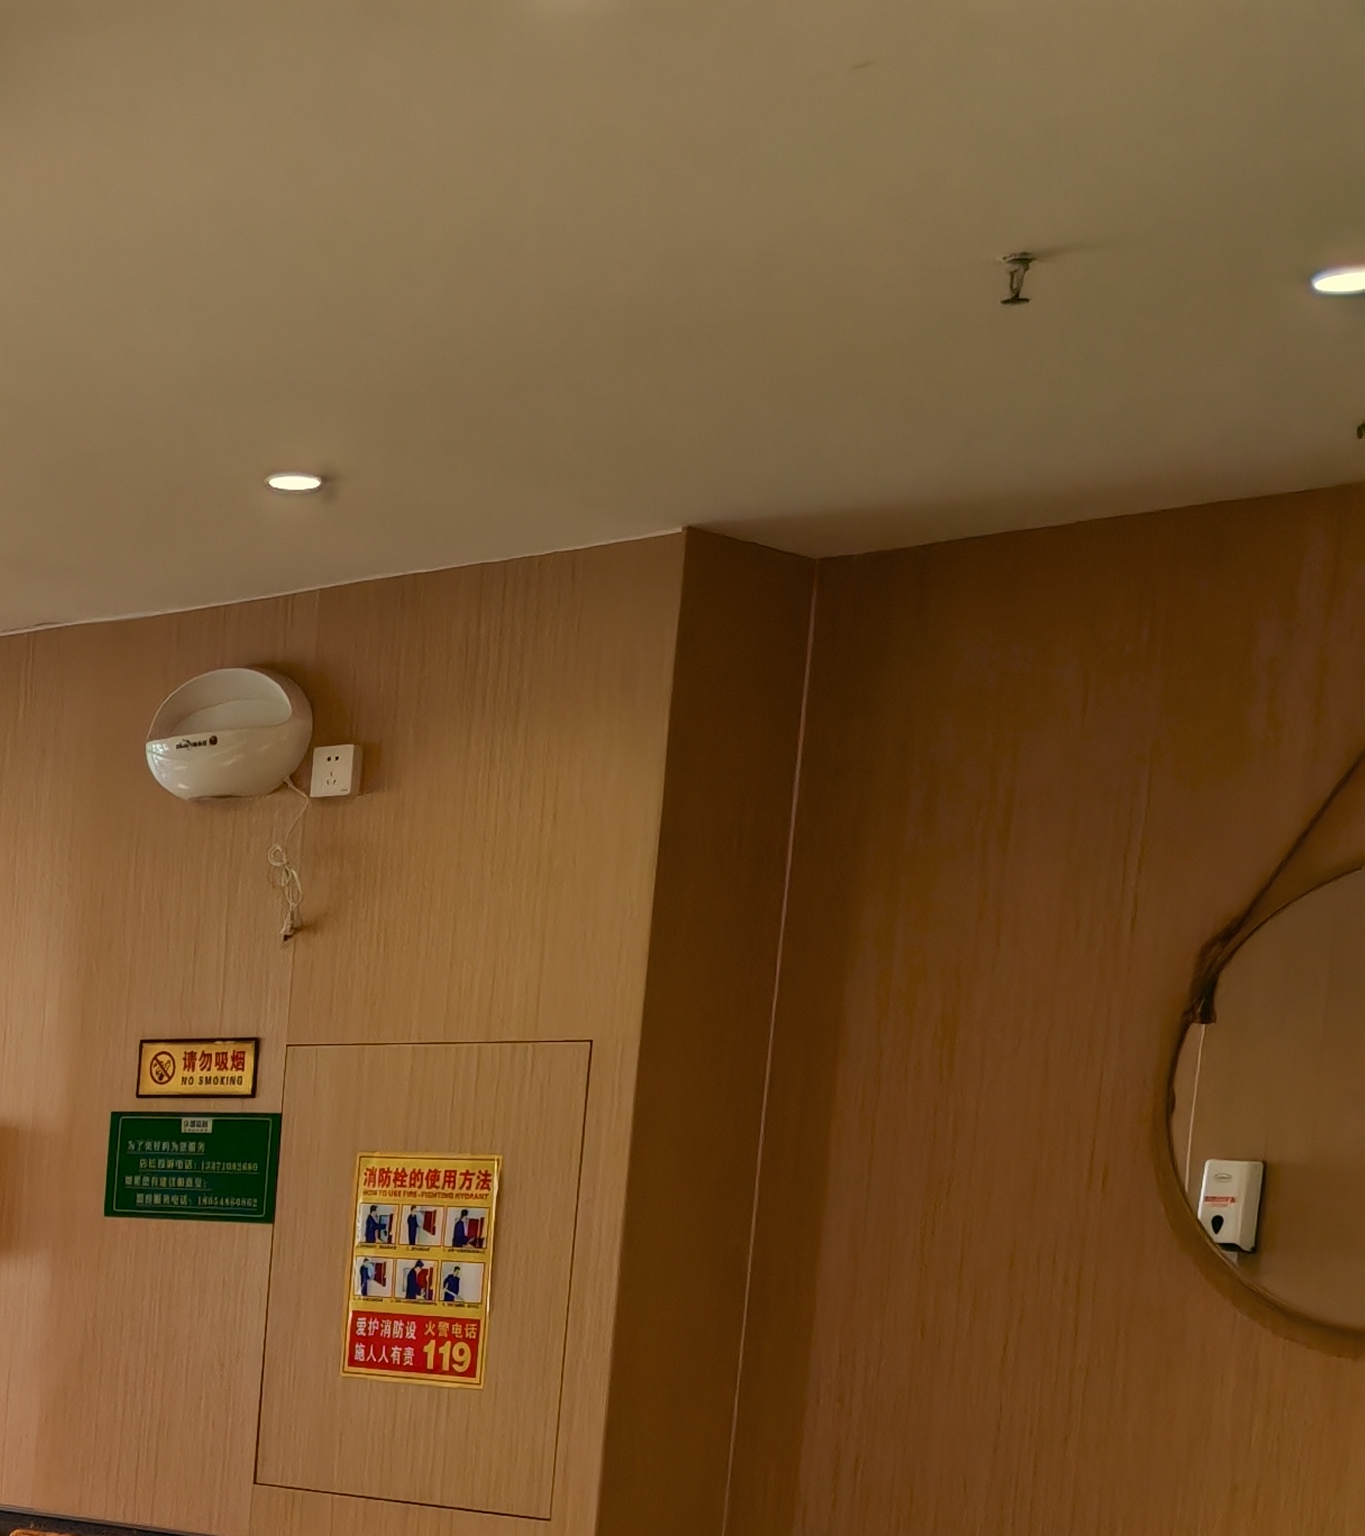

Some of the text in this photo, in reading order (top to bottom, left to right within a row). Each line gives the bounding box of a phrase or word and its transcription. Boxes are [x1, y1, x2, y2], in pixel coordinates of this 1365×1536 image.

[183, 1050, 246, 1072] 请勿吸烟
[181, 1076, 243, 1086] NO SMOKING
[363, 1167, 492, 1191] 消防栓的使用方法
[356, 1317, 478, 1340] 爱护消防设 火警电话
[354, 1339, 472, 1373] 施人人有责 119
